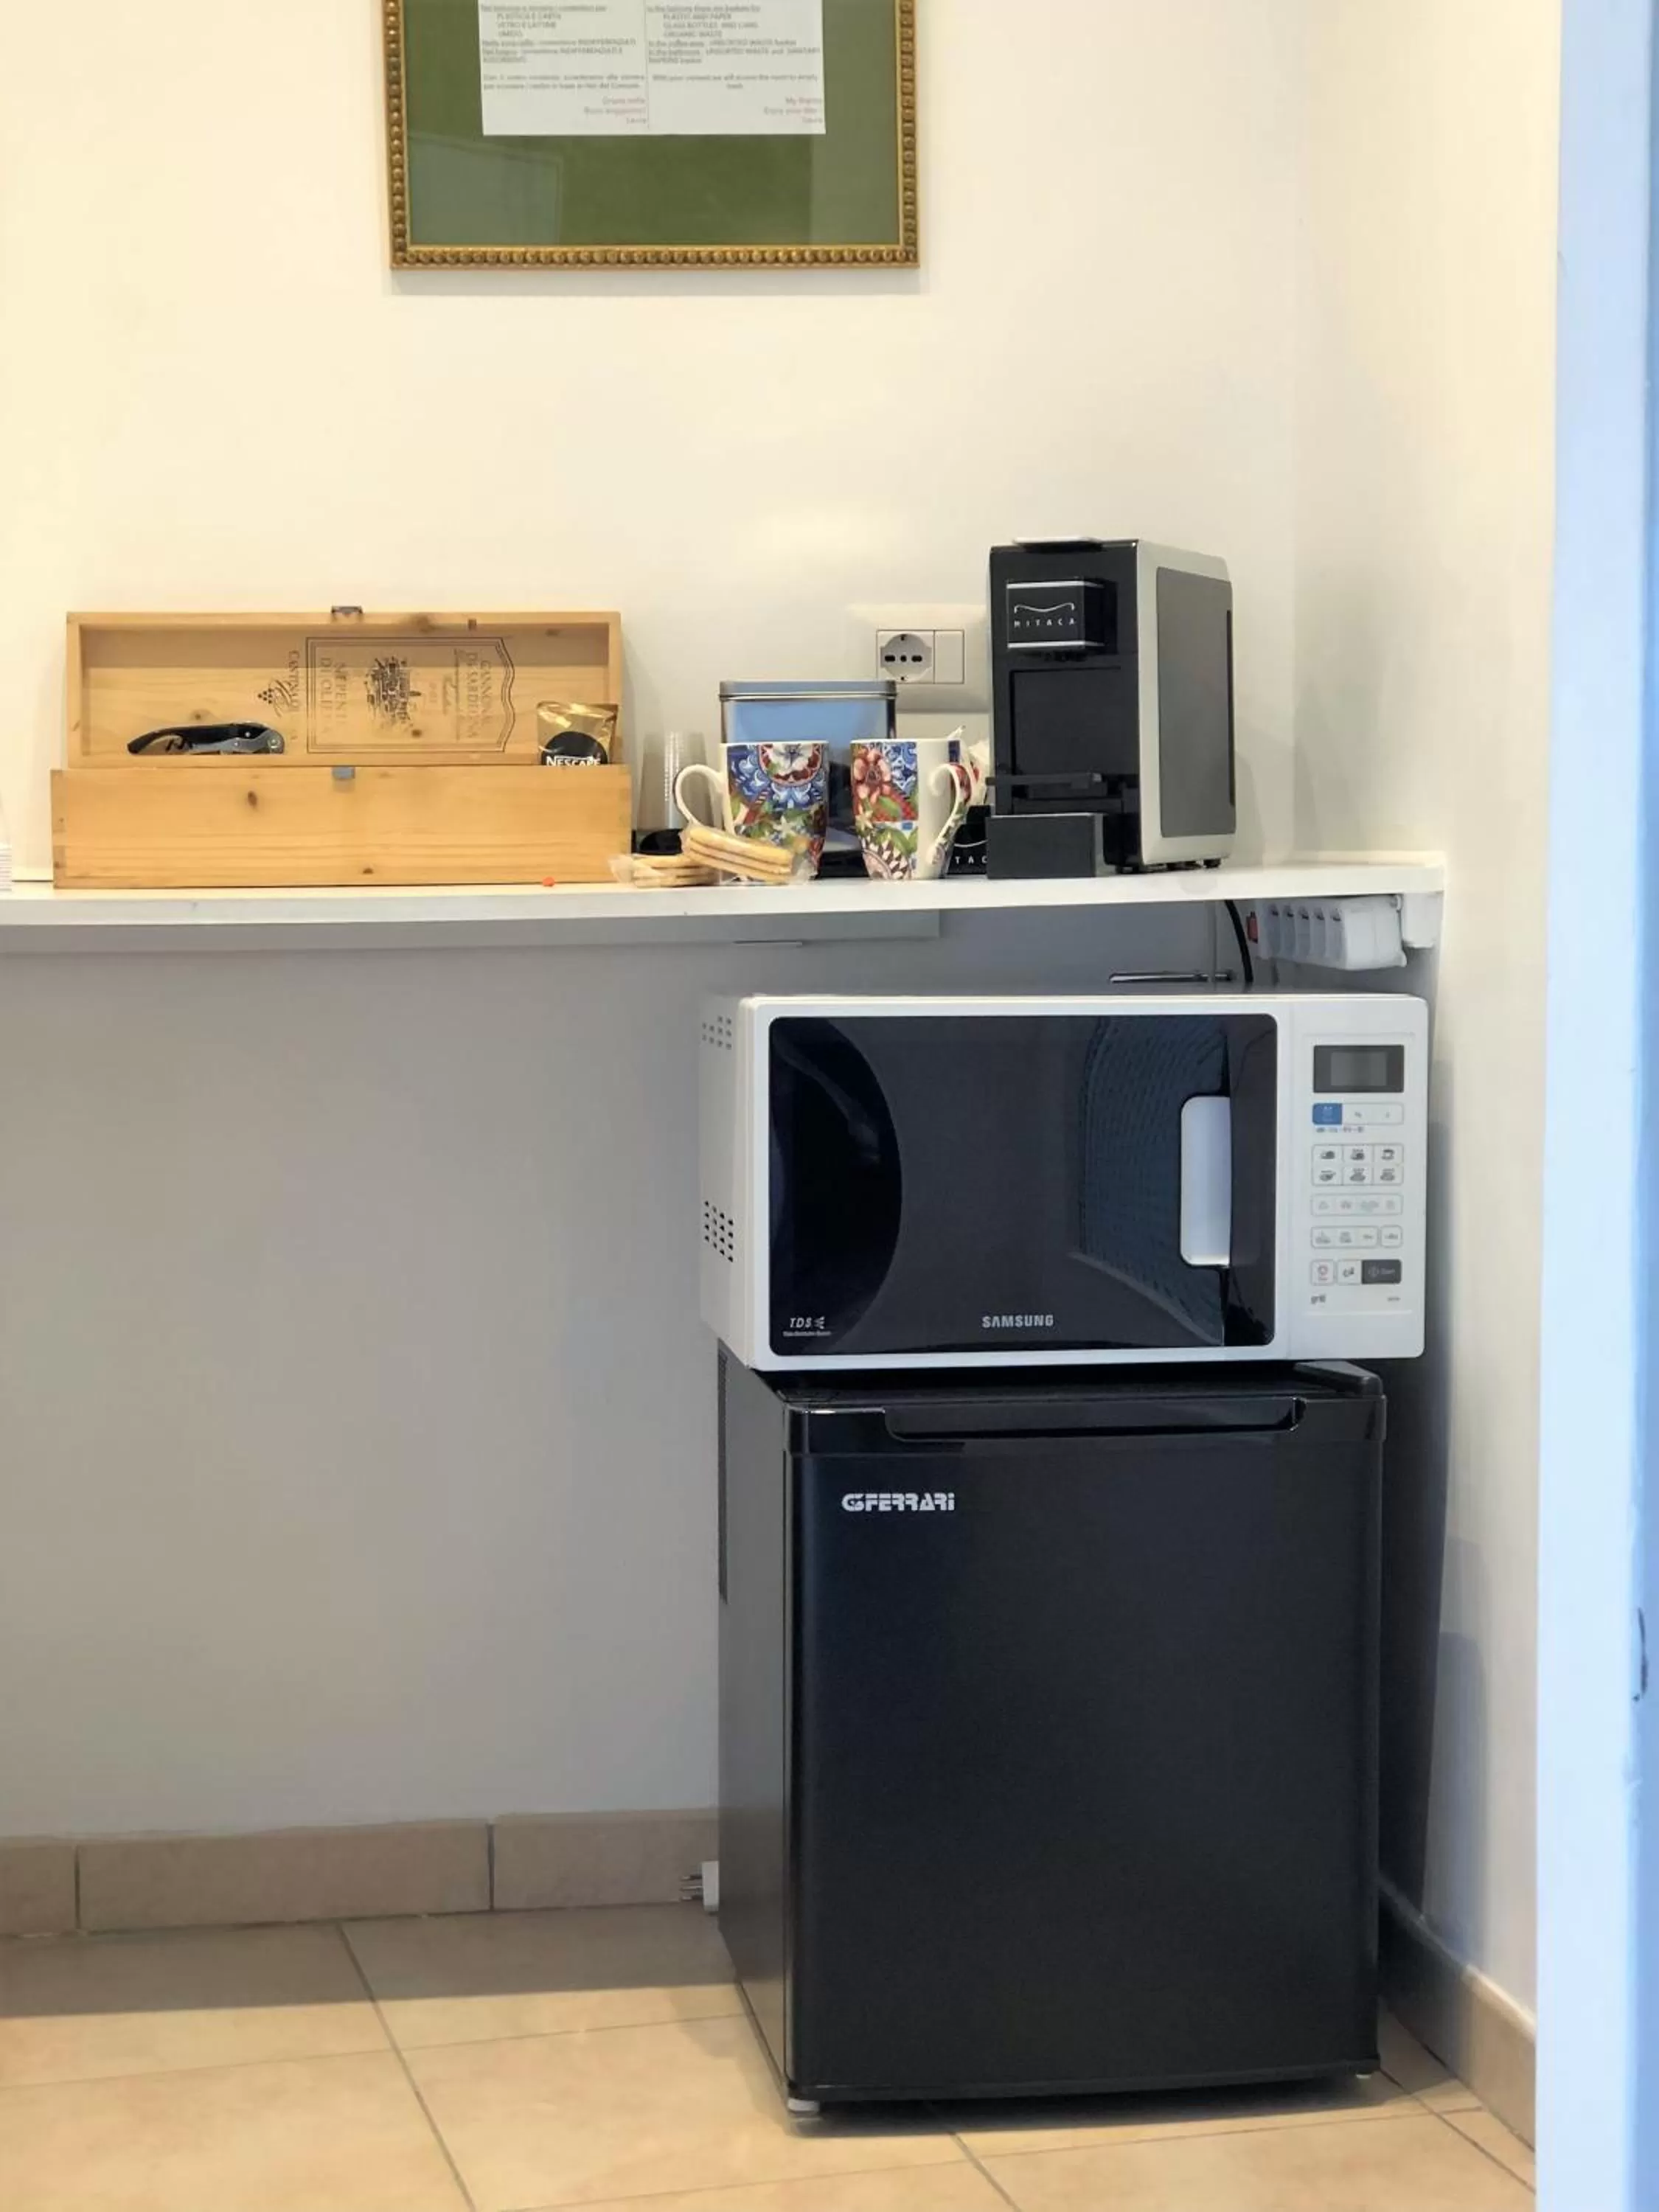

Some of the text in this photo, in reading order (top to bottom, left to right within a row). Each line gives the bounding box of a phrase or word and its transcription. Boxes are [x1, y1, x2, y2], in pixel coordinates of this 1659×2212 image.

[1014, 617, 1077, 628] MITACA
[955, 855, 988, 864] TAC
[790, 1317, 812, 1328] TDS
[981, 1315, 1054, 1328] SAMSUNG
